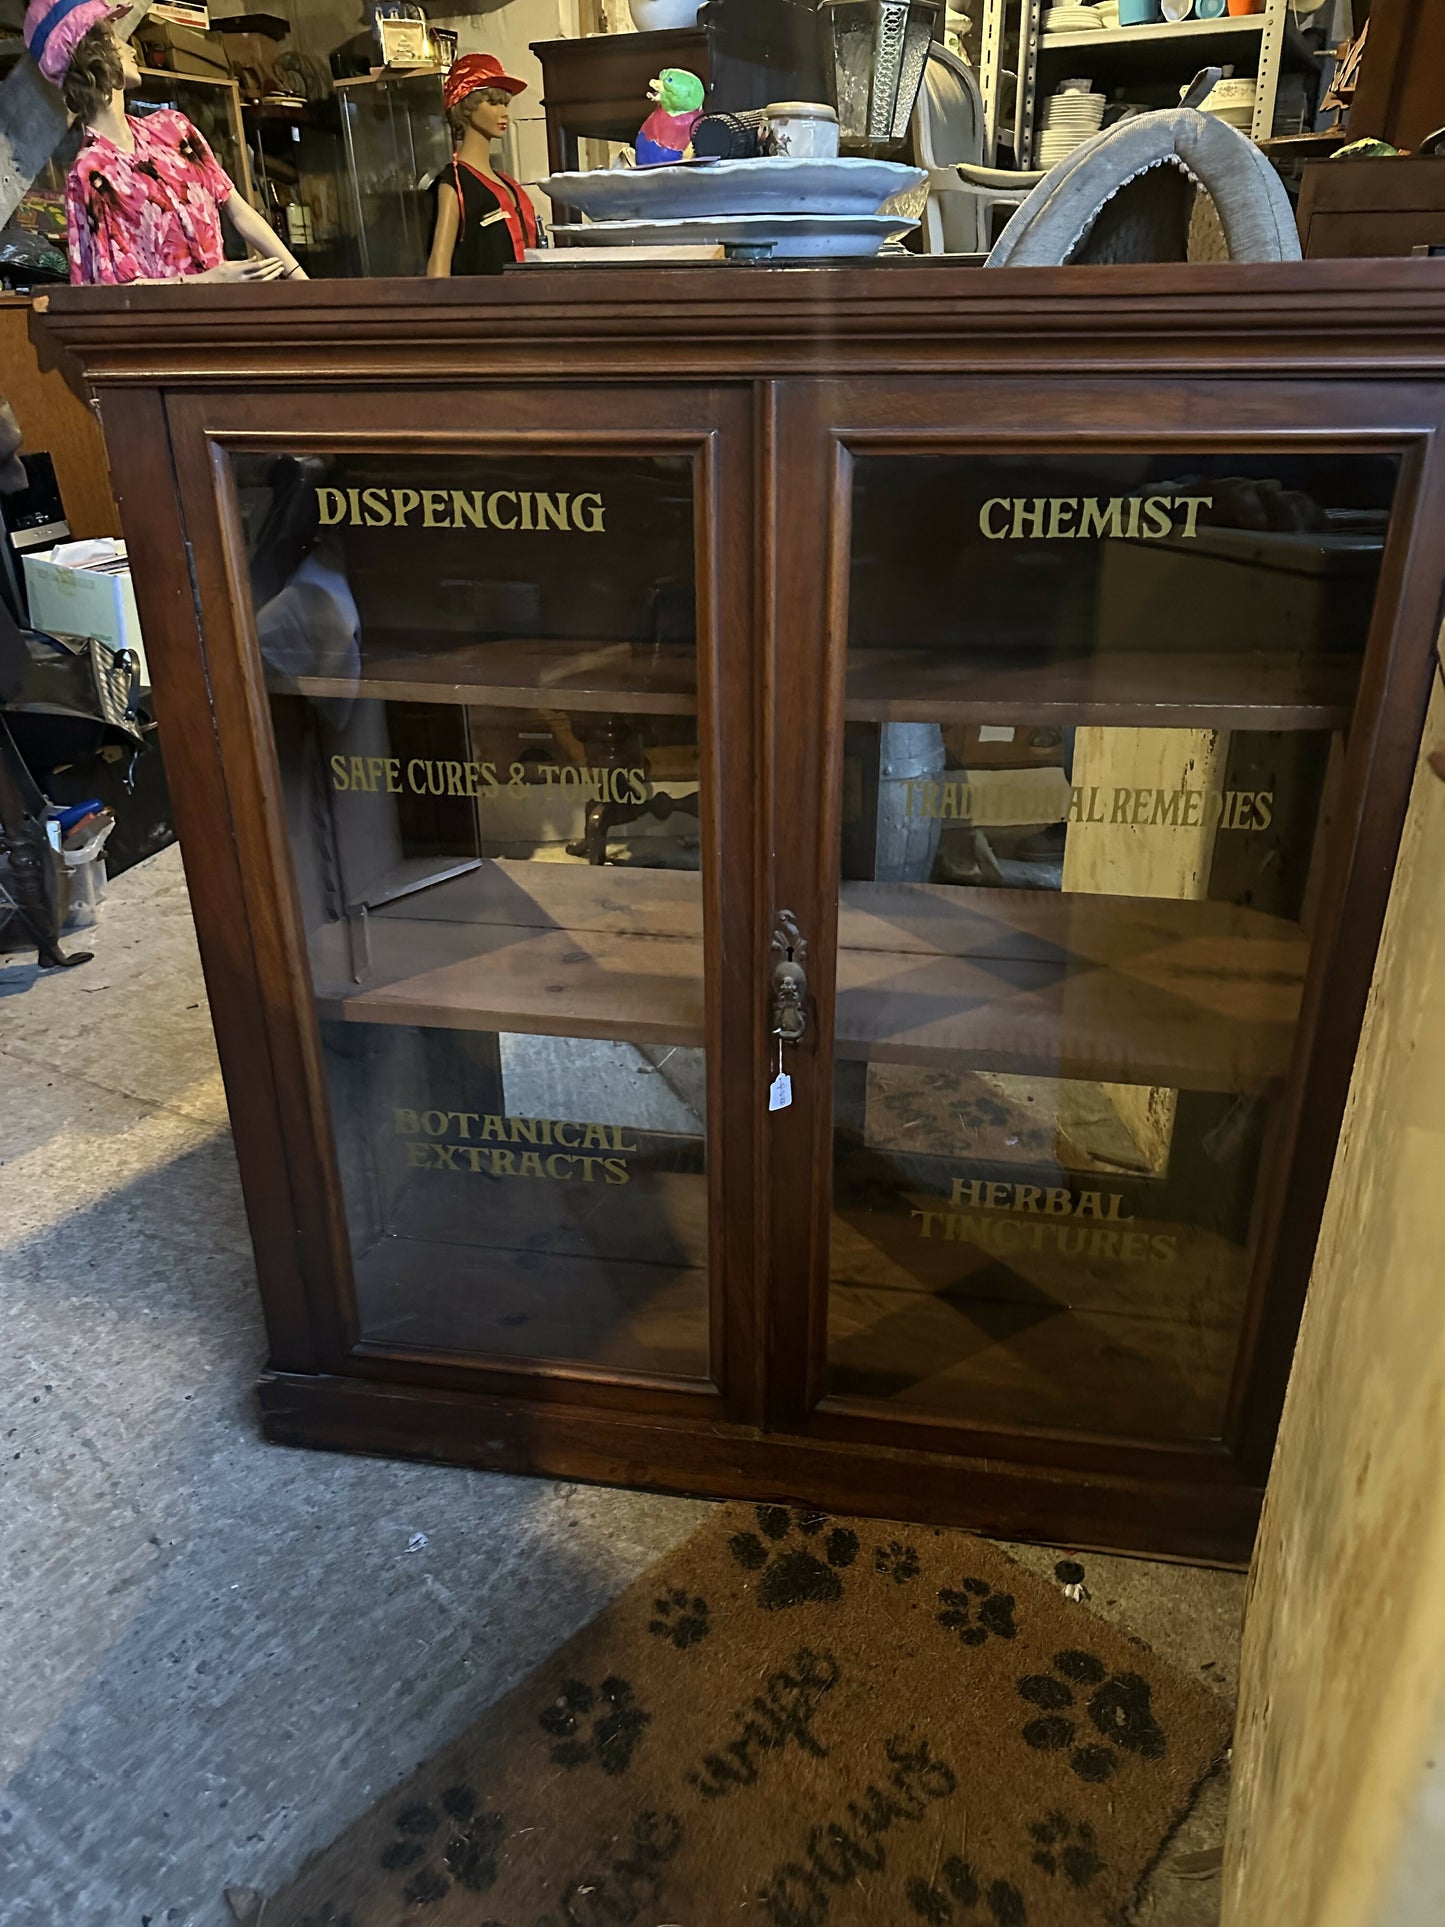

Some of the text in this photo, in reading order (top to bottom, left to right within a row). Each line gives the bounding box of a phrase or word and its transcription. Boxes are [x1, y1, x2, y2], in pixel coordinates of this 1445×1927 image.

[315, 487, 606, 532] DISPENCING
[979, 496, 1213, 540] CHEMIST
[330, 754, 648, 805] SAFE CURES & TONICS
[1111, 788, 1273, 832] REMEDIES
[394, 1106, 637, 1152] BOTANICAL
[406, 1141, 630, 1185] EXTRACTS
[949, 1177, 1135, 1223] HERBAL
[911, 1209, 1178, 1264] TINCTURES
